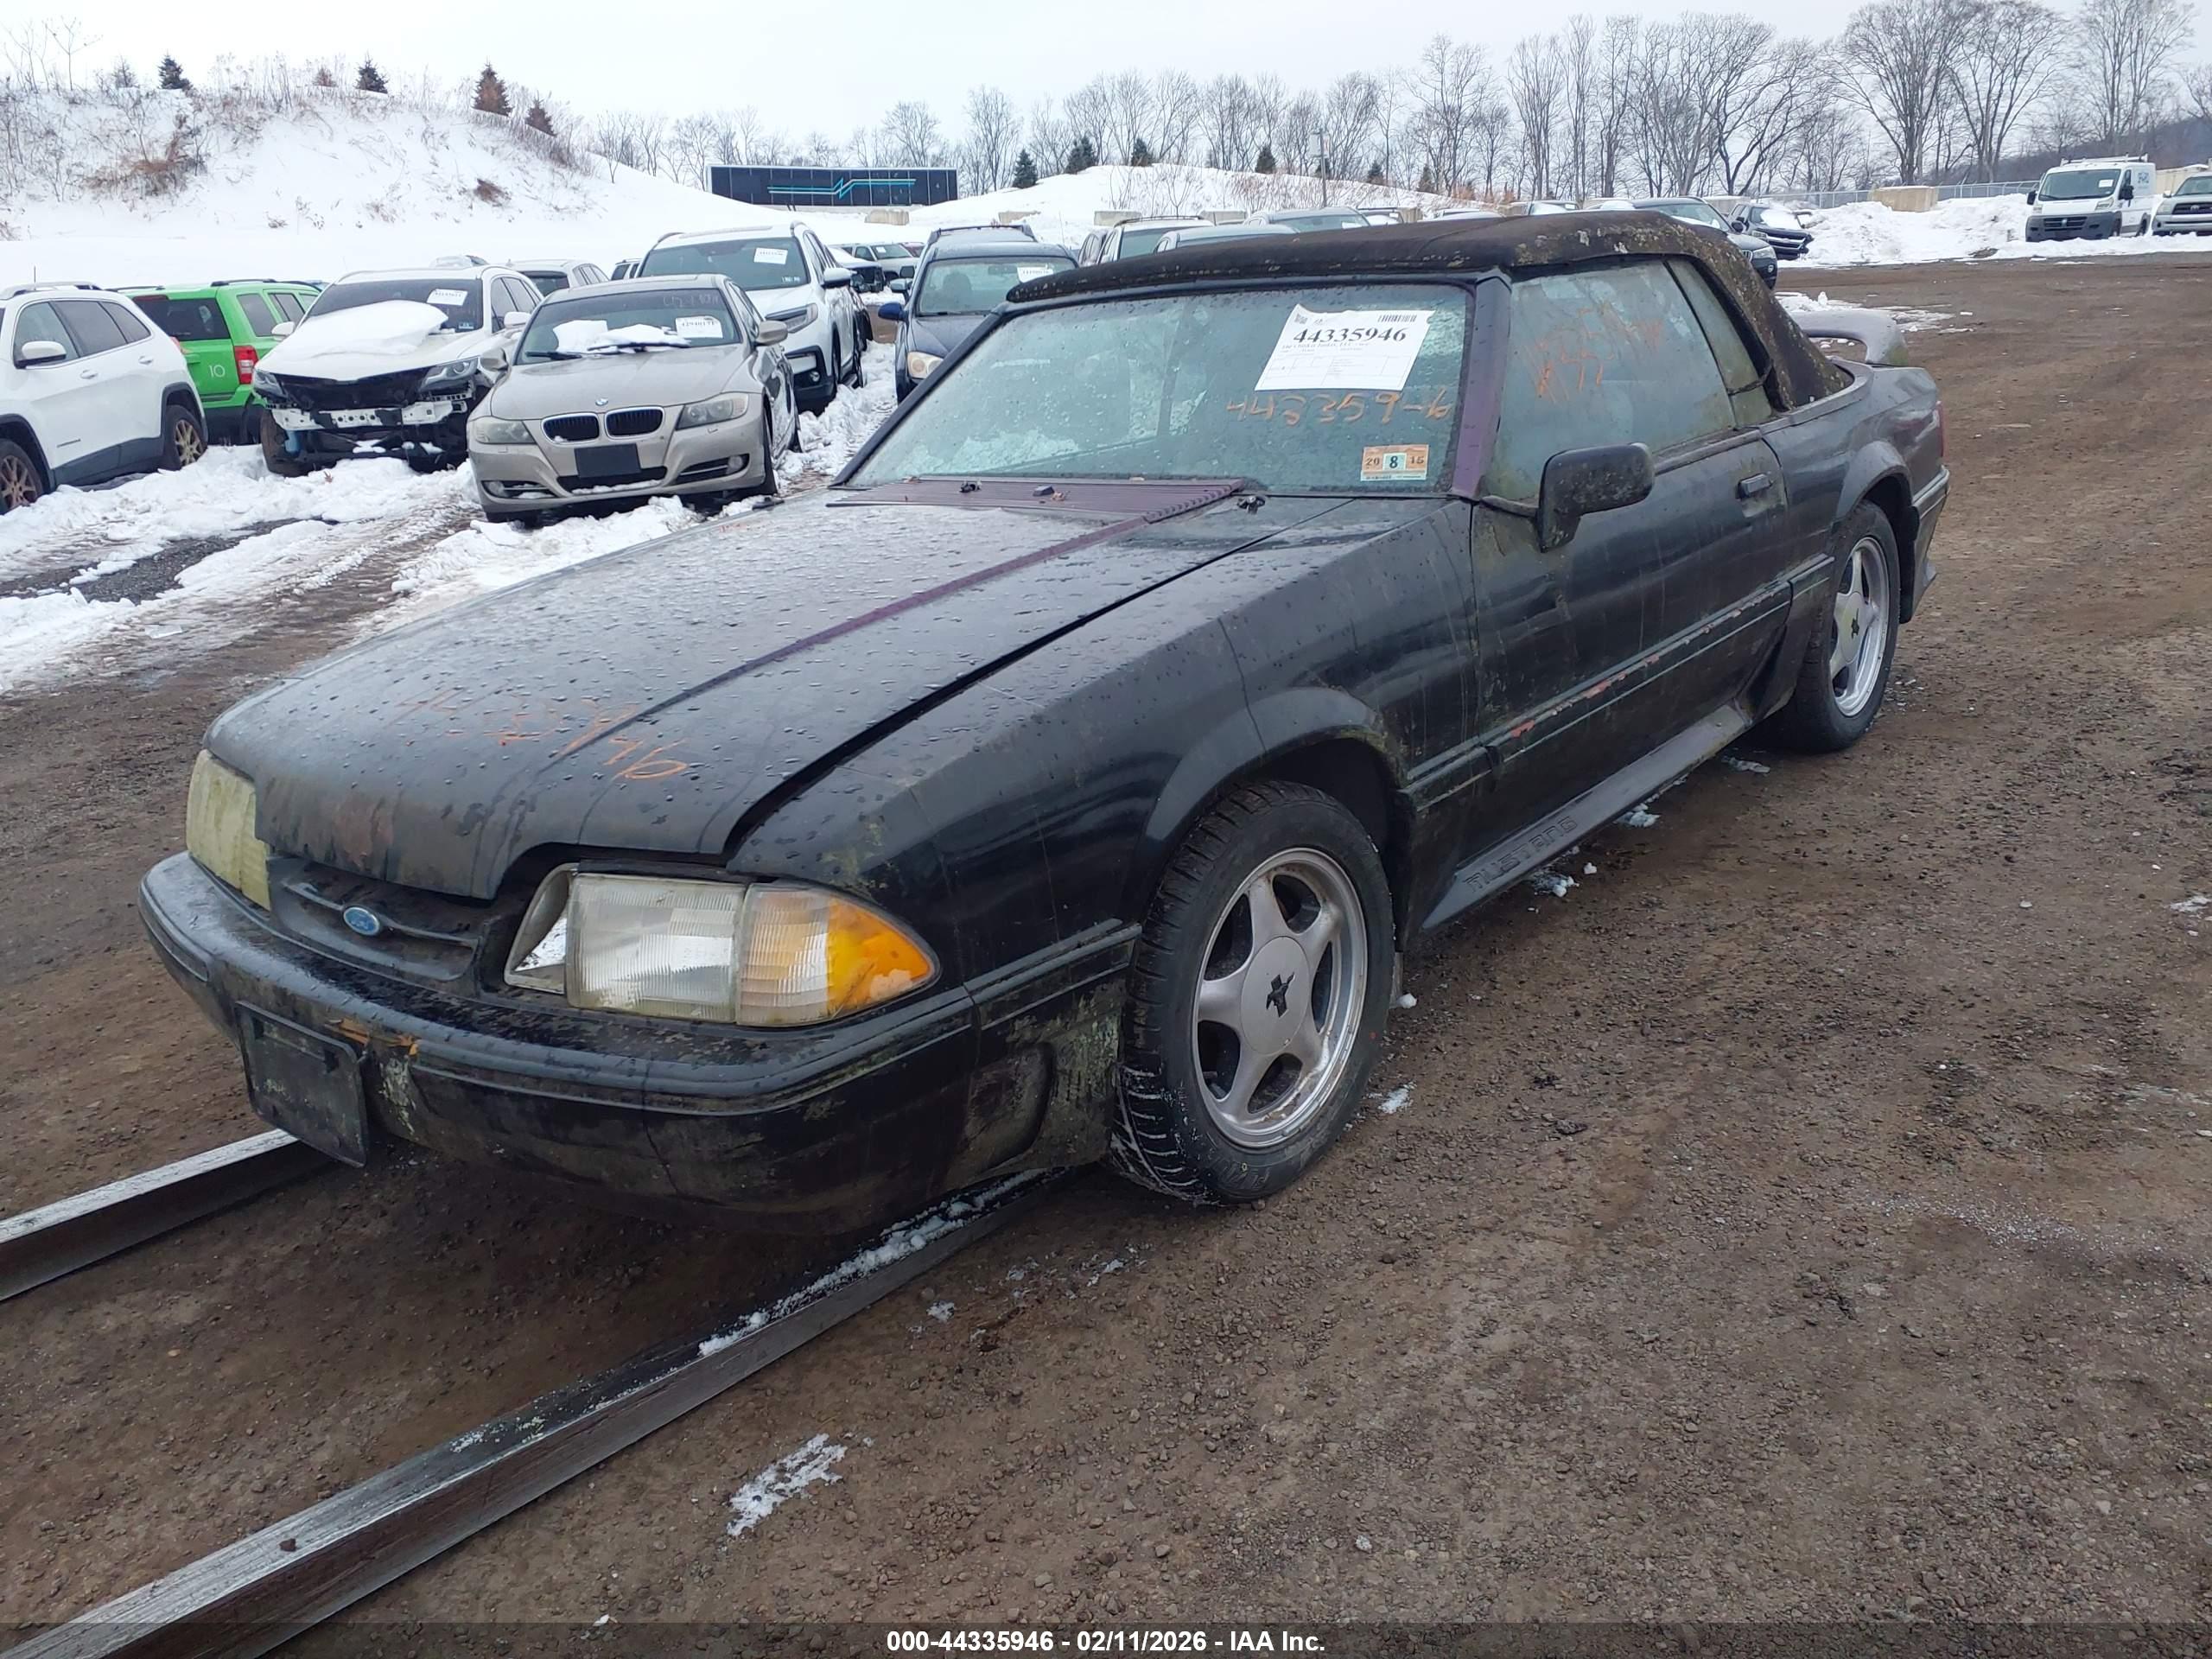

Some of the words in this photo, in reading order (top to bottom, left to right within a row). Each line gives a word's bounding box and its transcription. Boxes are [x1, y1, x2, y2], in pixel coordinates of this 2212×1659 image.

[1293, 327, 1410, 344] 44335946
[208, 365, 226, 378] 10
[1365, 457, 1380, 466] 20
[1389, 455, 1398, 468] 8
[1409, 455, 1425, 464] 15
